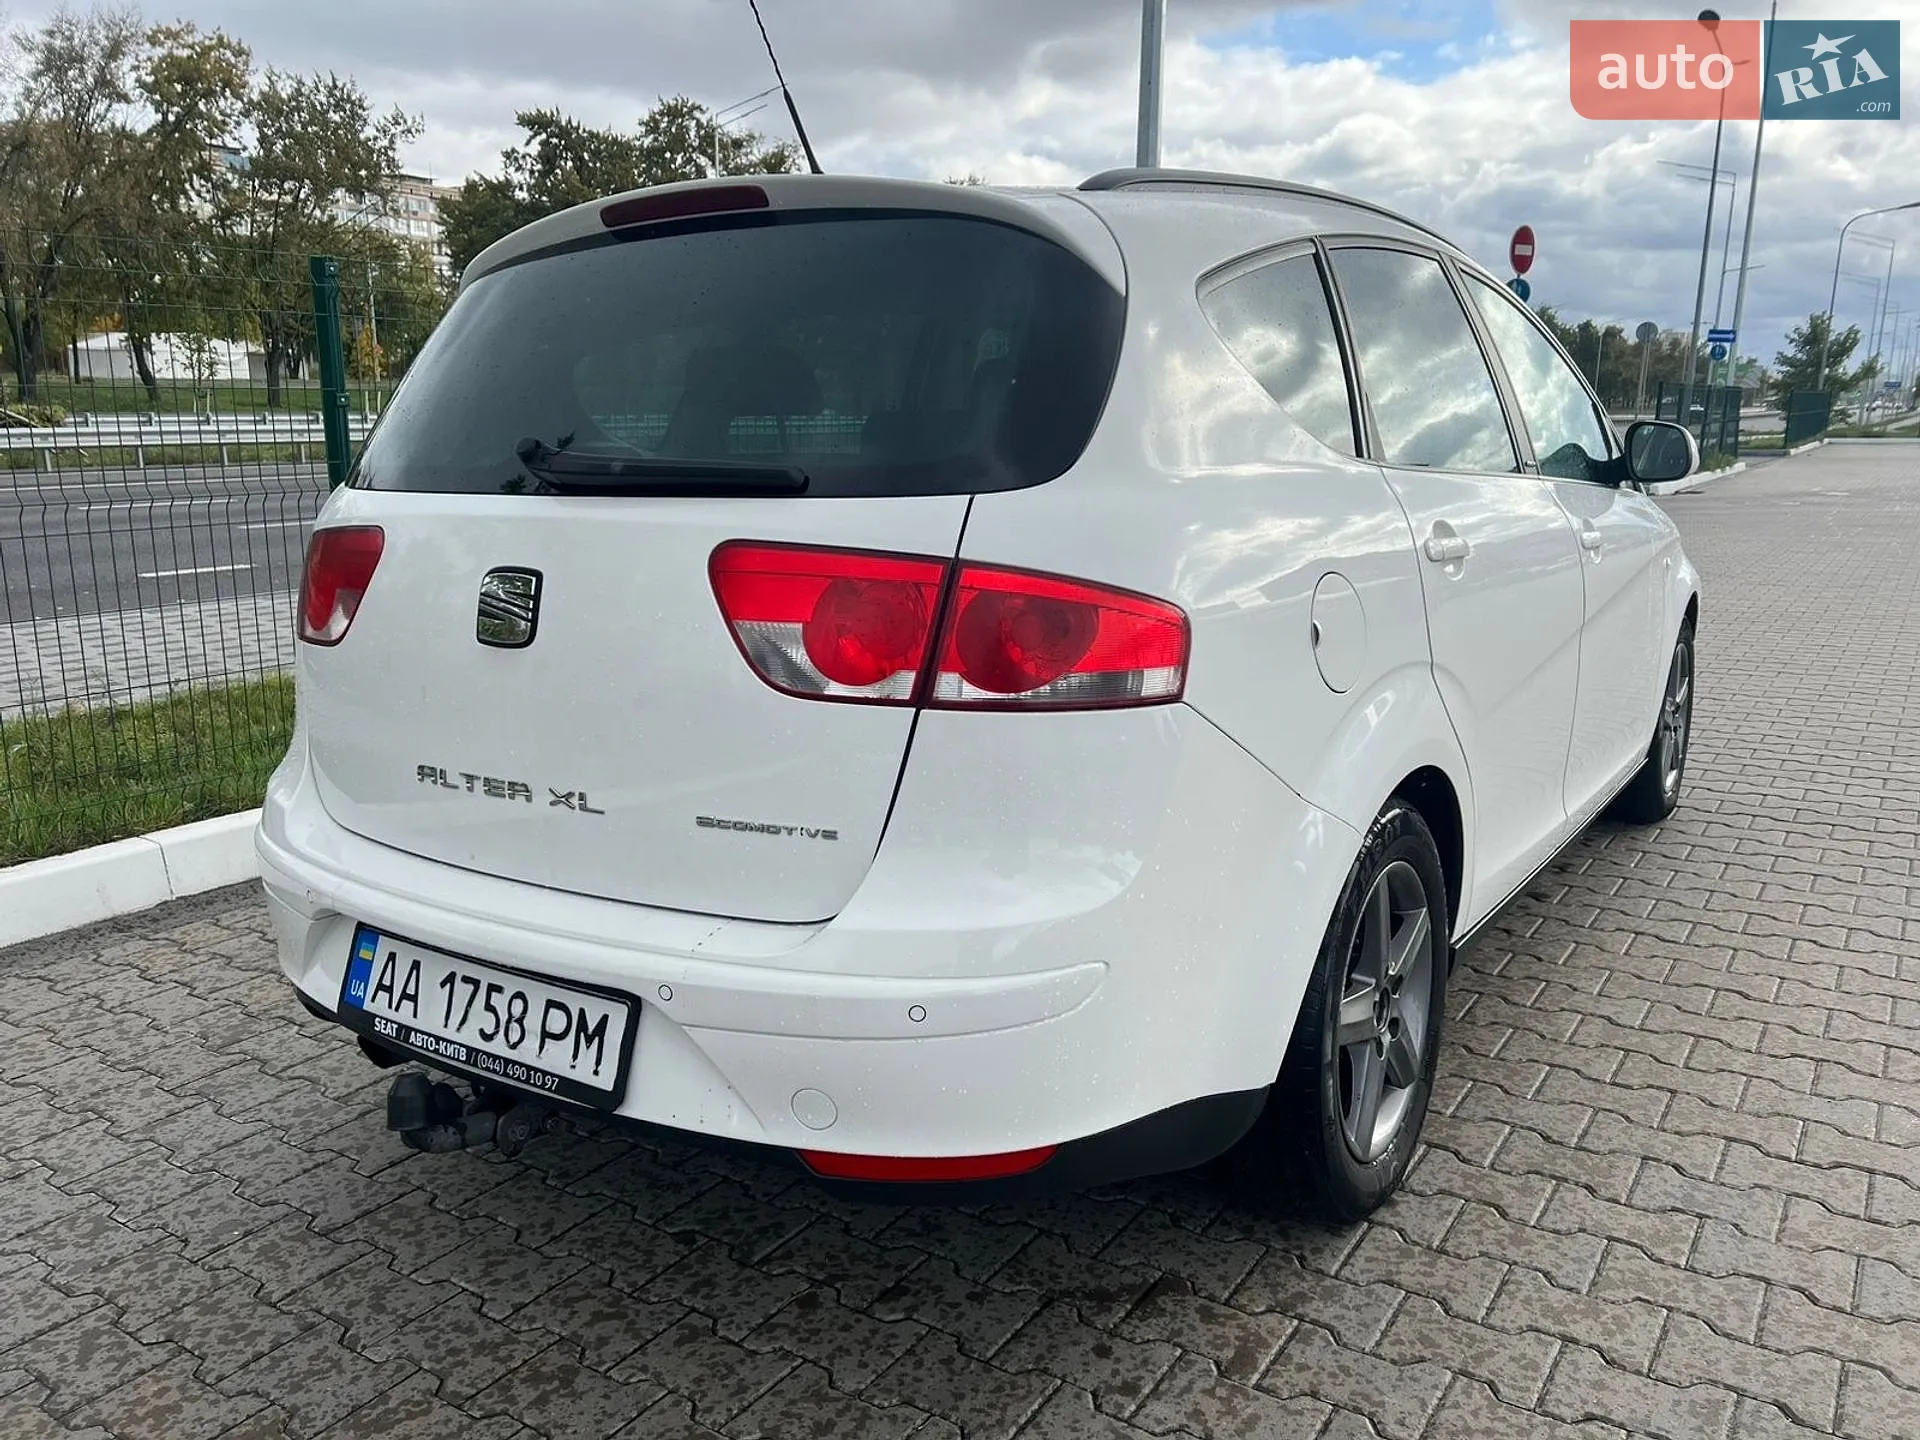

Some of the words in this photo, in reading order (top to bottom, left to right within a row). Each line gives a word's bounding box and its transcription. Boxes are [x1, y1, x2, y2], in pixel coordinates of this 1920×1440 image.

[548, 786, 605, 815] XL
[695, 815, 838, 841] ECOMOTIVE
[351, 979, 365, 999] UA
[371, 951, 421, 1019] AA
[439, 971, 529, 1050] 1758
[537, 998, 610, 1076] PM
[374, 1017, 399, 1037] SEAT
[477, 1052, 505, 1075] (044)
[506, 1063, 527, 1080] 490
[529, 1070, 543, 1086] 10
[544, 1075, 560, 1091] 97
